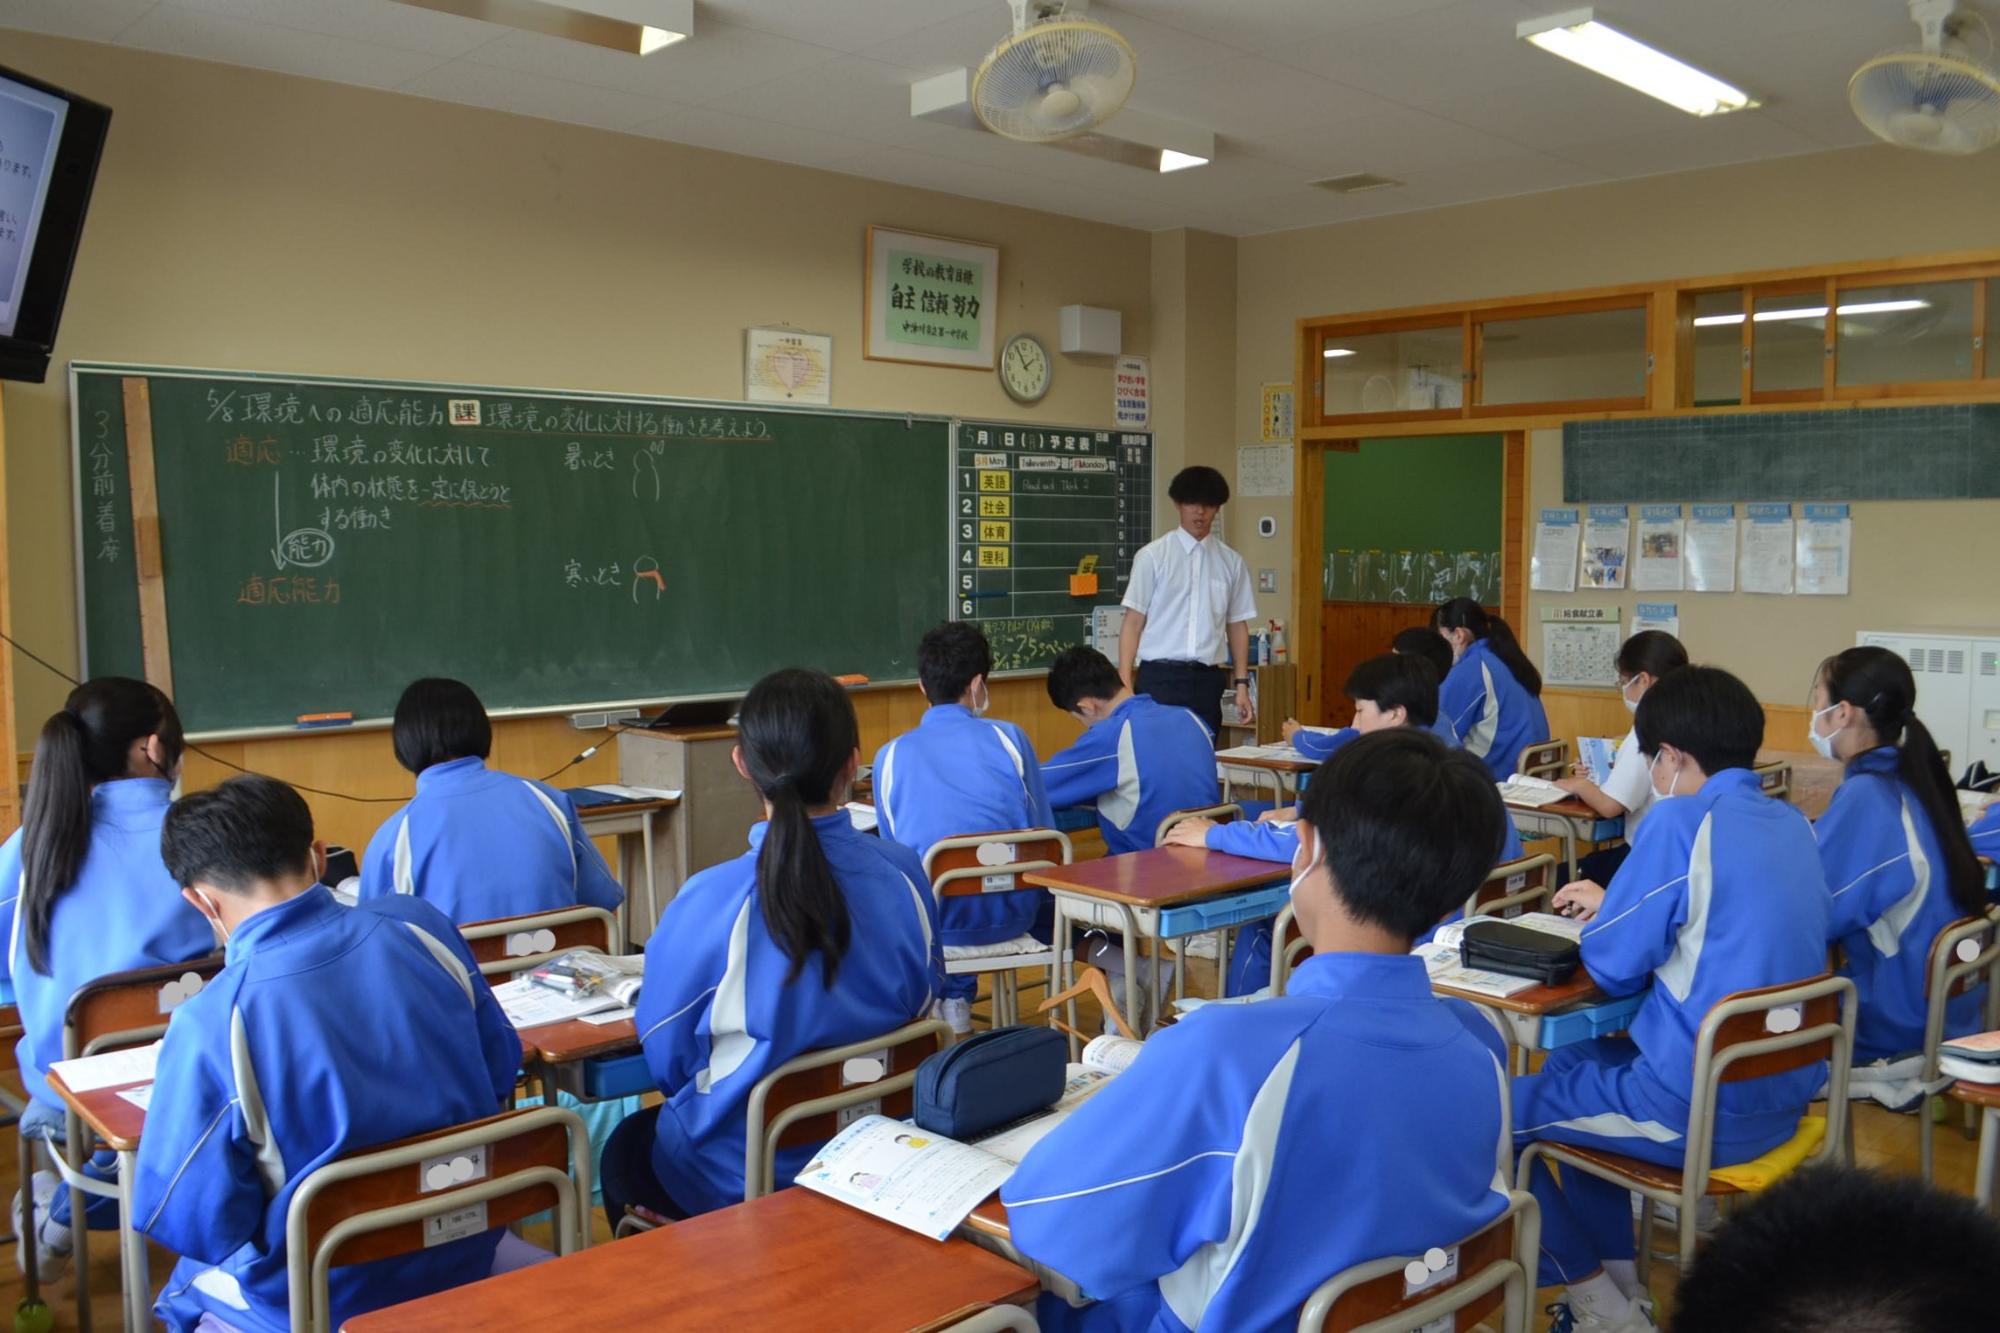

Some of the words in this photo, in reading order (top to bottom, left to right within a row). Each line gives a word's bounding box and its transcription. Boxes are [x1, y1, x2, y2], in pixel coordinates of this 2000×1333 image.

[902, 257, 974, 285] 学校の教育目標
[892, 282, 916, 310] 自主
[921, 289, 949, 316] 信頼
[952, 294, 980, 319] 努力
[240, 392, 444, 427] 環境への適応能力
[455, 403, 476, 421] 課
[225, 434, 282, 466] 適応
[564, 442, 616, 471] 暑いとき
[89, 410, 121, 564] 3分前着席
[310, 475, 512, 504] 体内の状態を一定に保とうと
[963, 474, 970, 488] 1
[983, 475, 1006, 490] 英語
[962, 499, 972, 513] 2
[983, 501, 1006, 516] 社会
[320, 506, 392, 531] する働き
[962, 524, 973, 539] 3
[983, 525, 1006, 540] 体育
[286, 536, 327, 560] 能力
[962, 550, 973, 564] 4
[981, 550, 1005, 565] 理科
[564, 558, 623, 589] 寒いとき
[962, 575, 973, 589] 5
[237, 576, 342, 605] 適応能力
[962, 600, 973, 616] 6
[436, 1217, 442, 1230] 1
